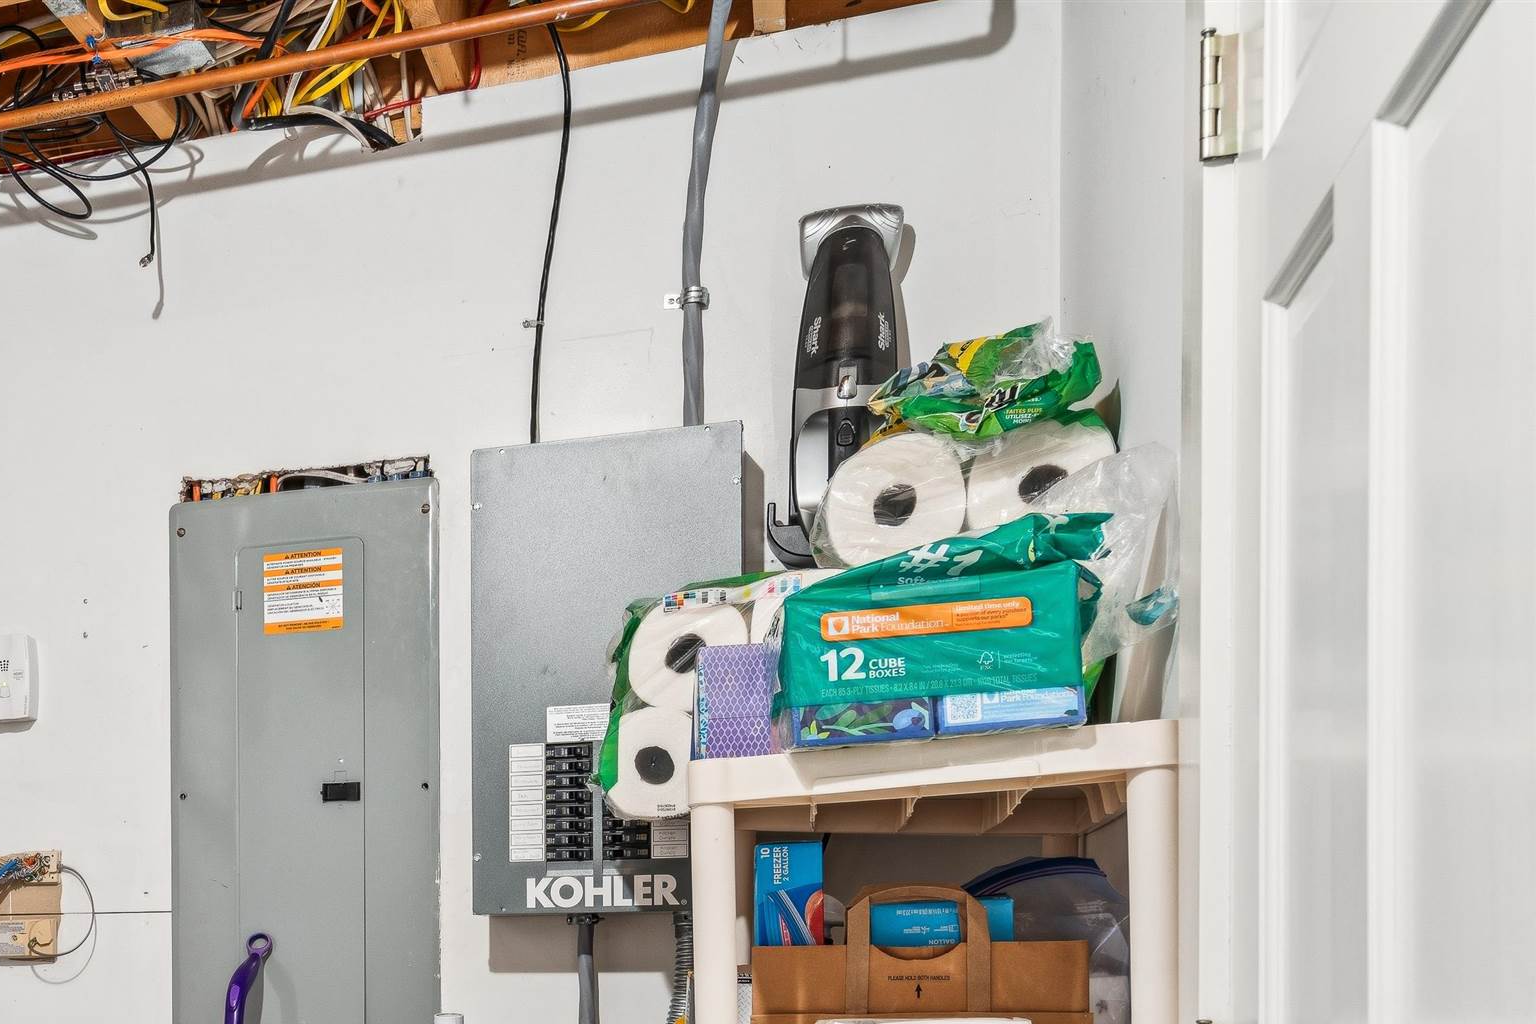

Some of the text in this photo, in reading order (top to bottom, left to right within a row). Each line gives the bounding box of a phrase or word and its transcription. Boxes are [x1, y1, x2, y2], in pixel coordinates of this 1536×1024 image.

[810, 316, 822, 358] Shark
[877, 311, 887, 351] Shark
[290, 551, 322, 560] ATTENTION
[290, 566, 322, 575] ATTENTION
[851, 612, 900, 625] National
[852, 619, 944, 634] Park Foundation
[819, 647, 866, 682] 12
[868, 657, 906, 669] CUBE
[869, 668, 906, 679] BOXES
[865, 684, 890, 694] TISSUES
[760, 847, 770, 859] 10
[773, 846, 782, 885] FREEZER
[526, 874, 680, 908] KOHLER
